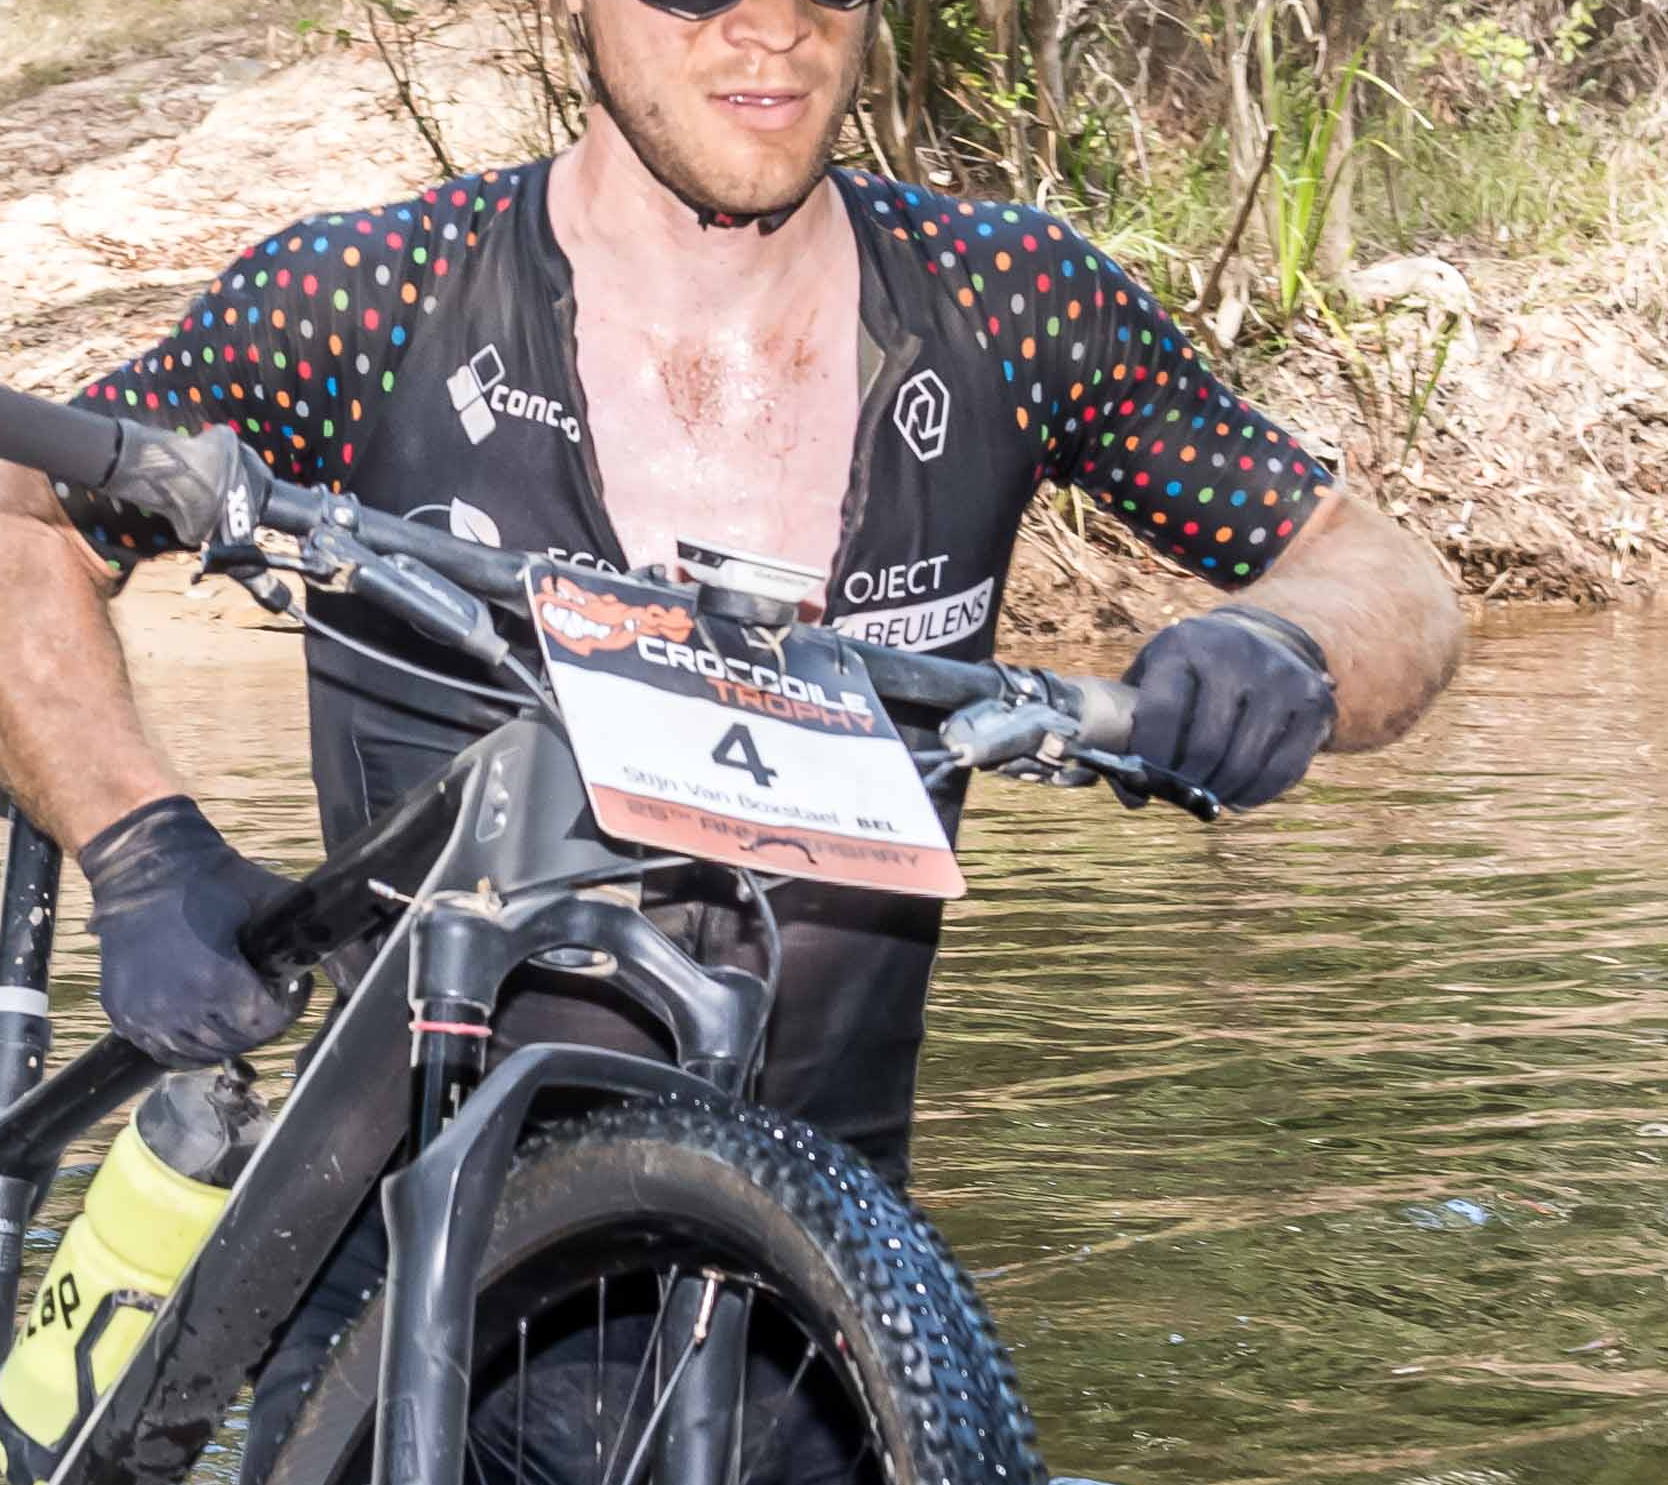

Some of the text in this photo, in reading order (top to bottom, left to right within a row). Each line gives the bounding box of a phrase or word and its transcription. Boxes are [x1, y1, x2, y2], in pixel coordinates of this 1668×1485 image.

[843, 553, 950, 605] OJECT
[865, 589, 989, 649] BEULENS
[636, 634, 874, 718] CROCODILE
[706, 673, 877, 735] TROPHY
[711, 722, 779, 788] 4
[856, 815, 900, 834] BEL
